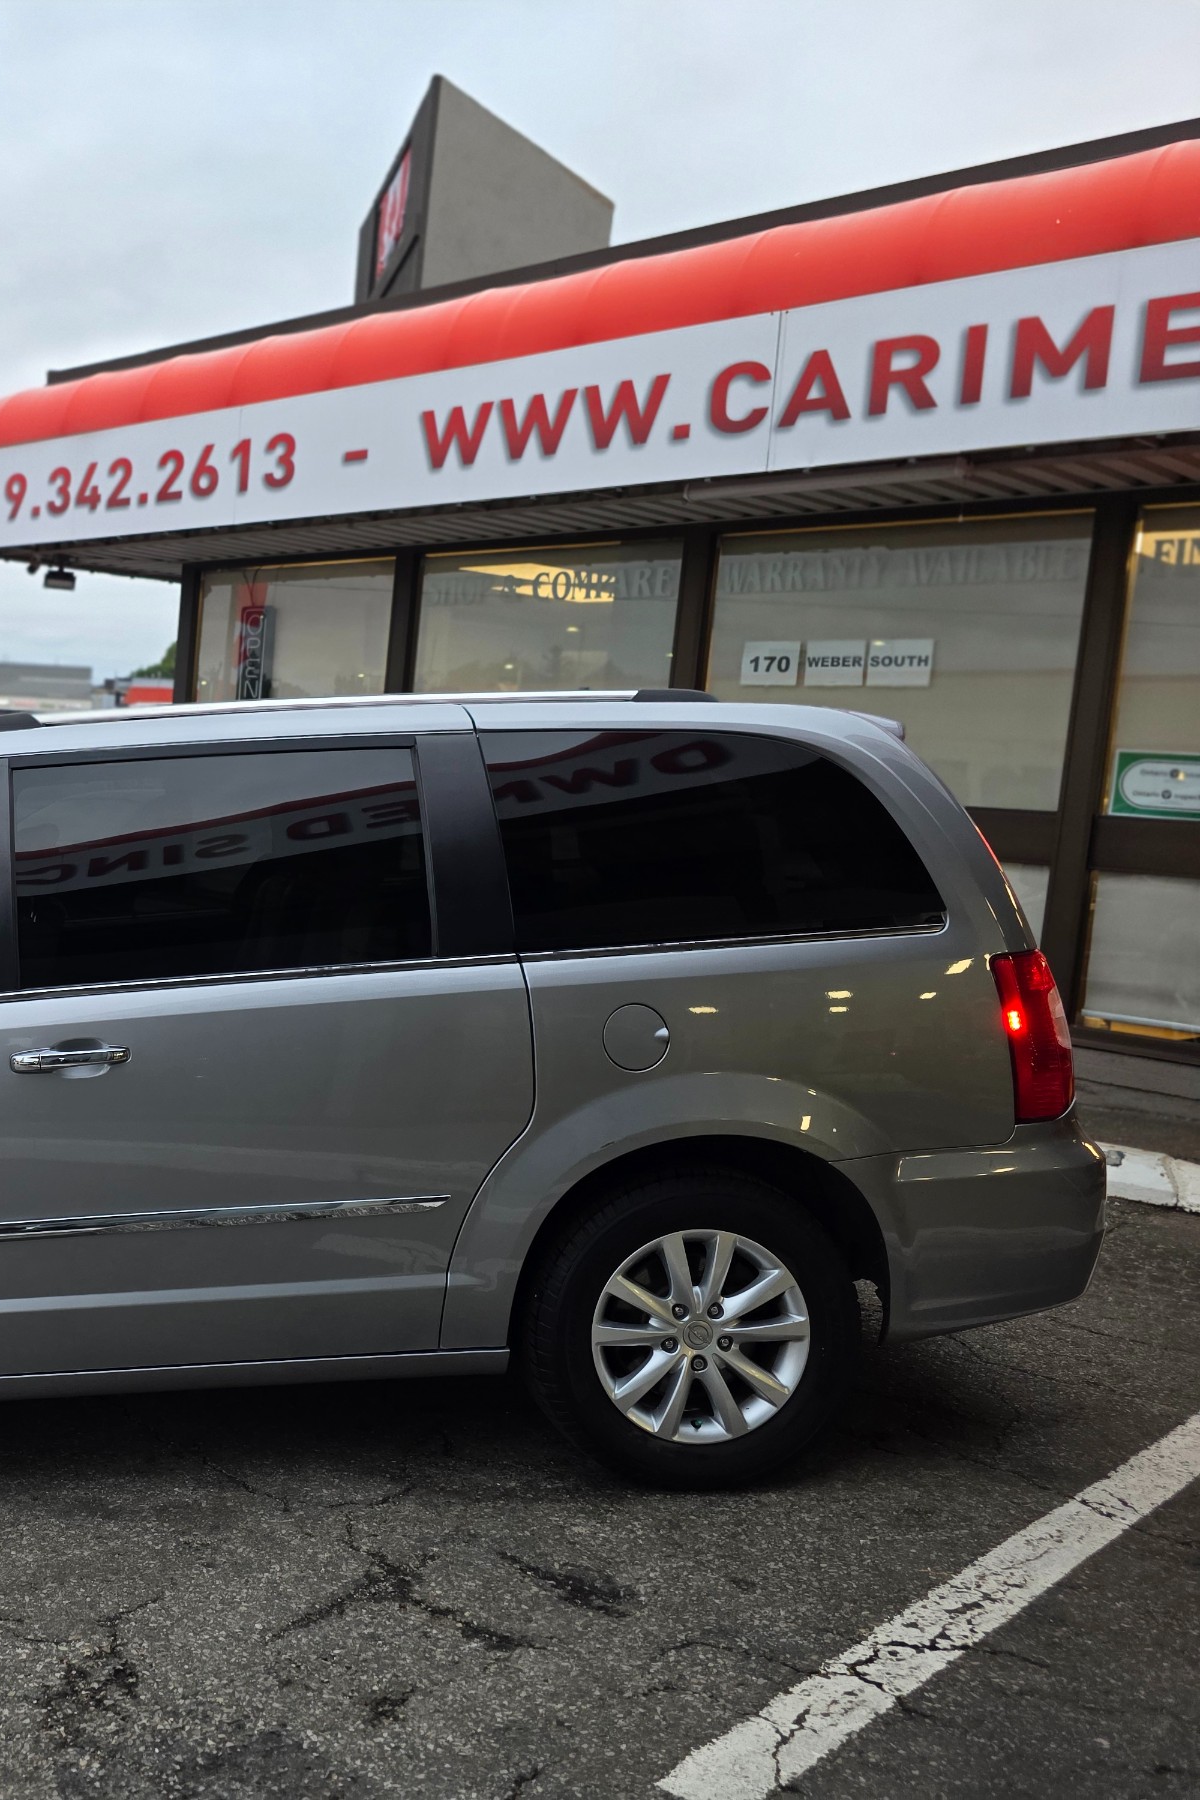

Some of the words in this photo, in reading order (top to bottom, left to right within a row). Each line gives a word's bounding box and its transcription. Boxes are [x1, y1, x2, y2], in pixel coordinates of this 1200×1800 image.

[422, 292, 1200, 471] WWW.CARIME
[531, 565, 677, 602] COMPARE
[722, 553, 892, 594] WARRANTY
[906, 541, 1084, 585] AVAILABLE
[243, 613, 263, 698] OPEN
[749, 655, 791, 673] 170
[807, 656, 863, 668] WEBER
[869, 655, 929, 667] SOUTH
